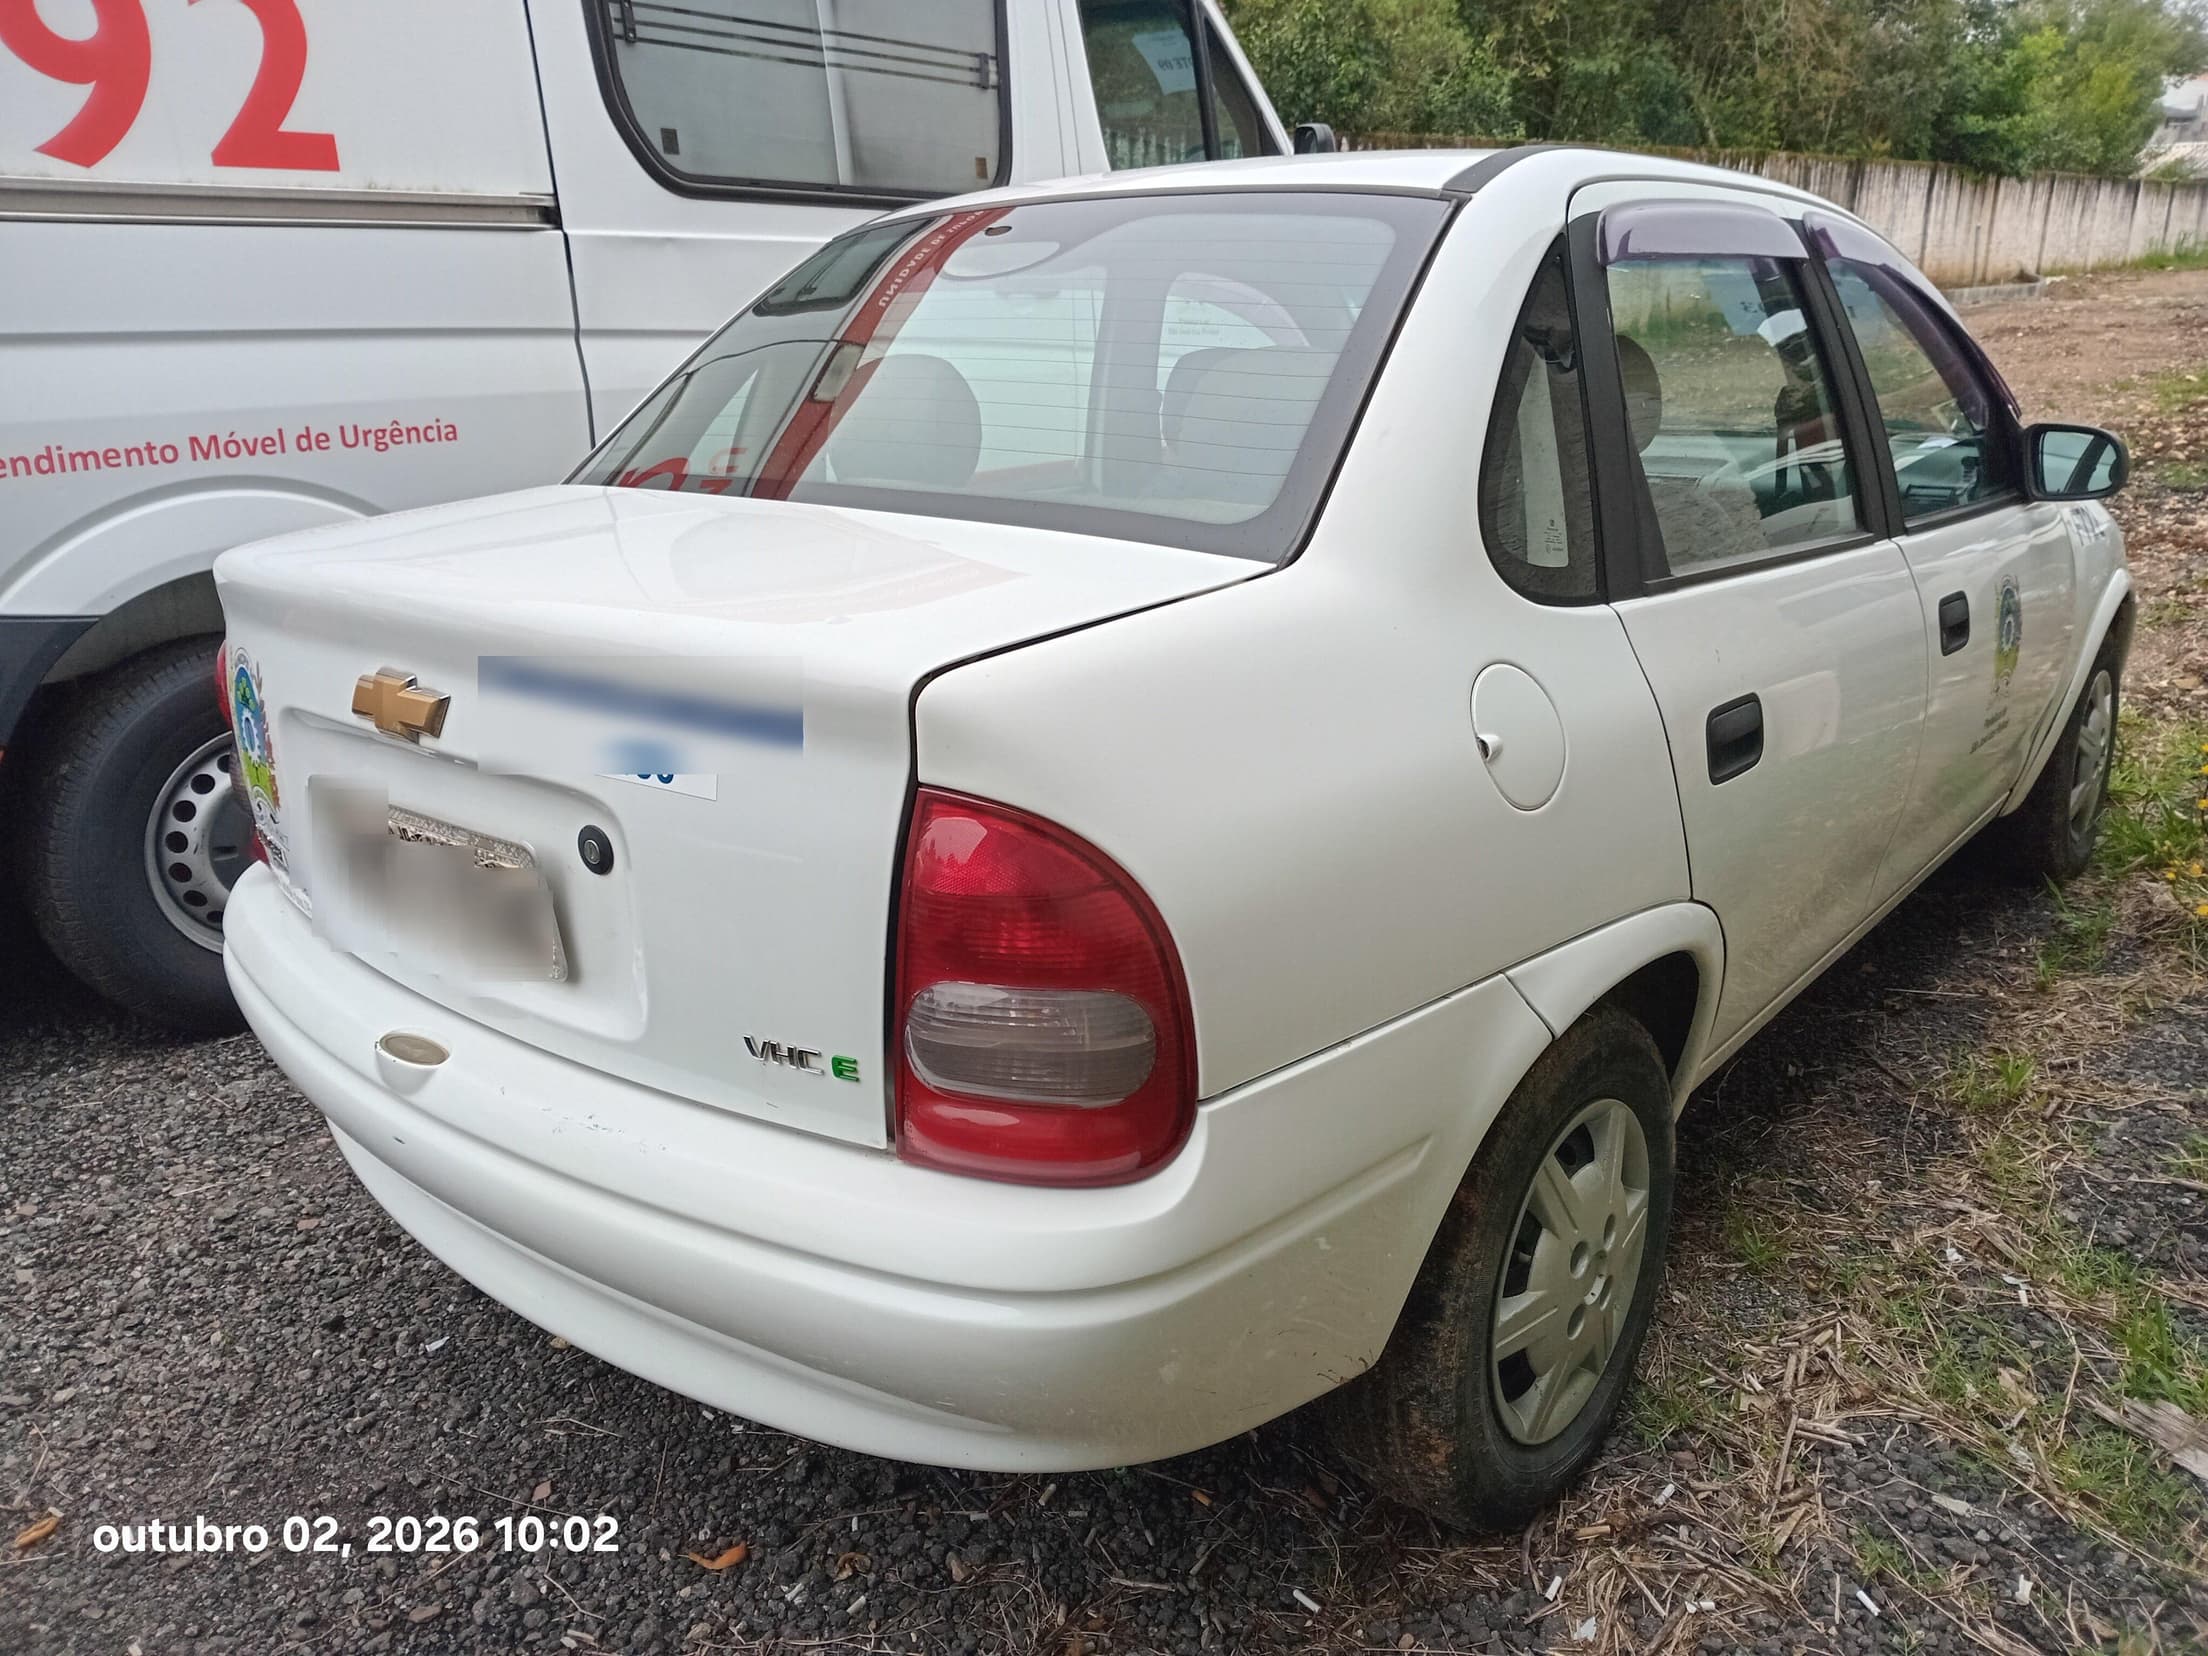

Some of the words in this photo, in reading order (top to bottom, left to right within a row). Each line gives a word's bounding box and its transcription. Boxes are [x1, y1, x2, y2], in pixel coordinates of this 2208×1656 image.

[187, 428, 287, 462] Móvel
[295, 425, 331, 453] de
[338, 418, 458, 452] Urgência
[743, 1034, 824, 1076] VHC
[831, 1054, 860, 1083] E
